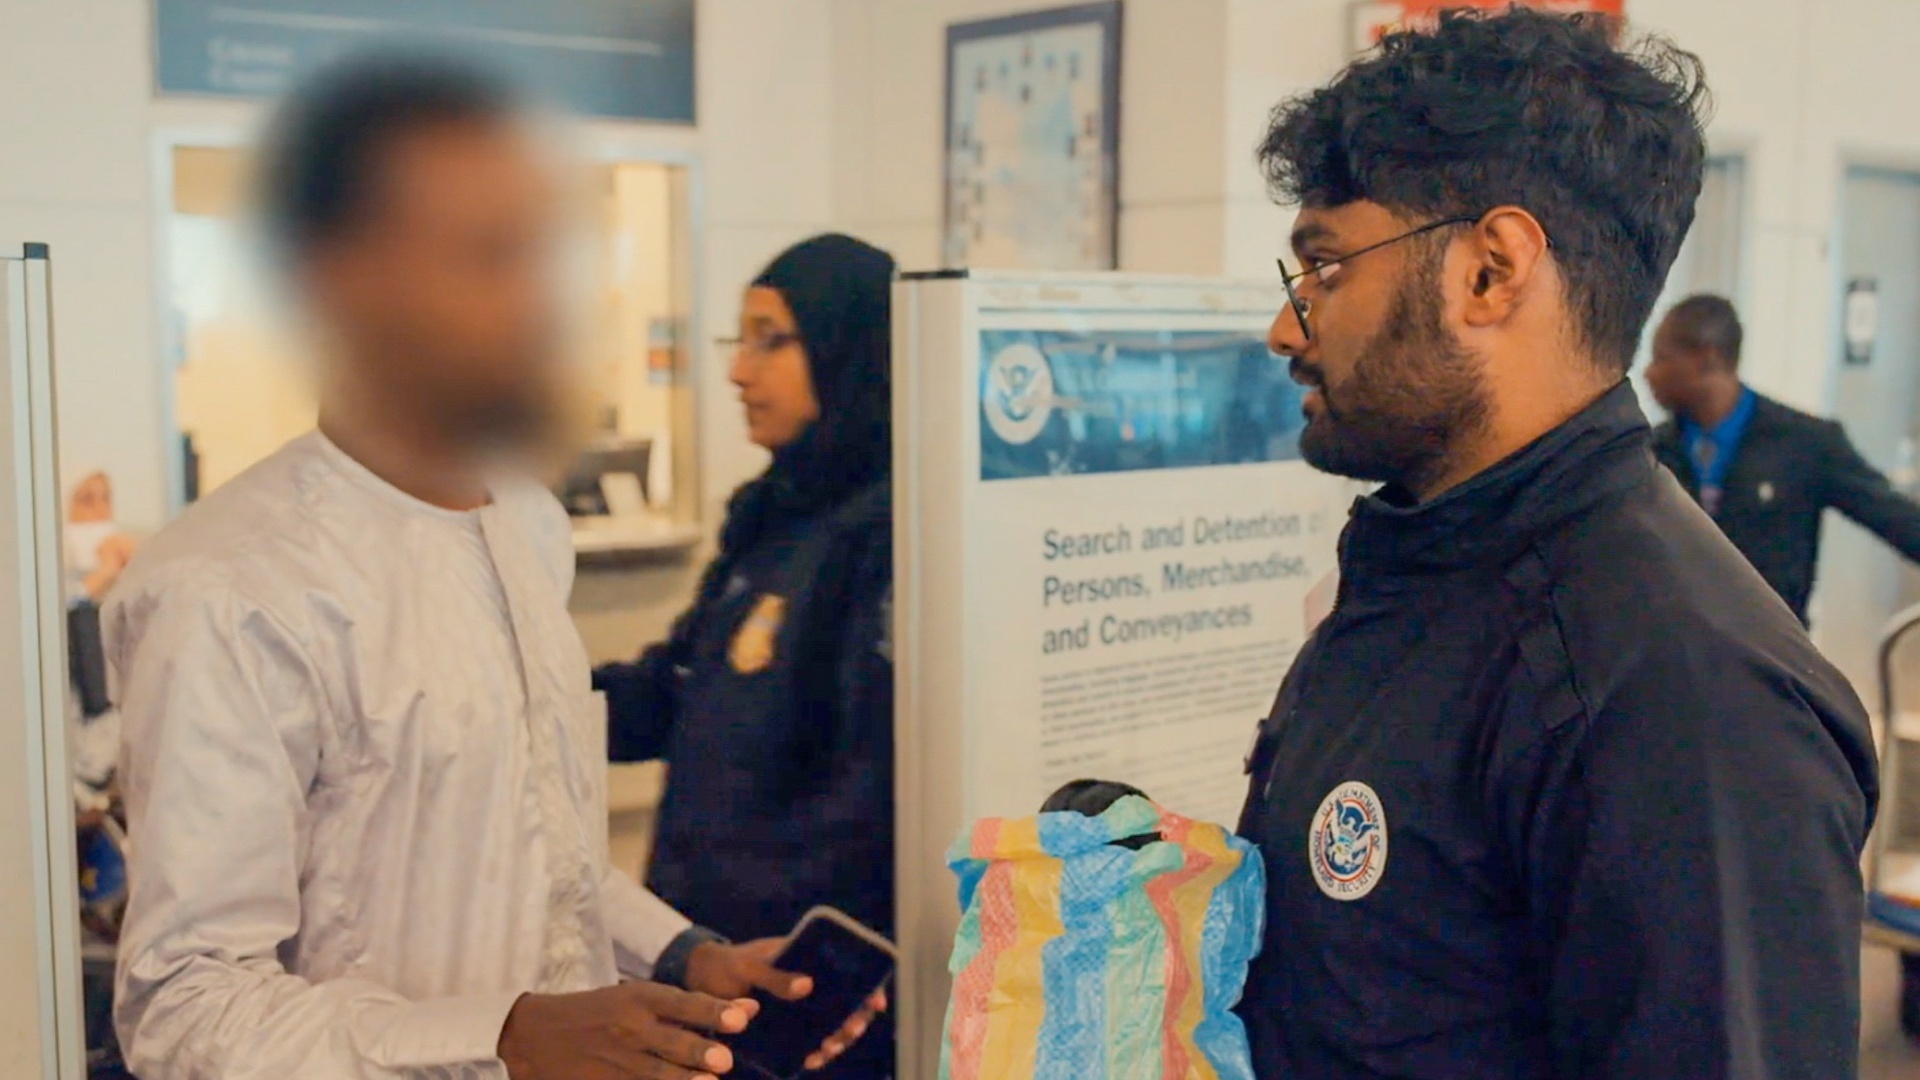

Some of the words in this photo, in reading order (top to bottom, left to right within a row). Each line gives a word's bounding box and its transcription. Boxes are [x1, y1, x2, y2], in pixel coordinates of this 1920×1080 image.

[1043, 523, 1132, 560] Search
[1141, 515, 1184, 550] and
[1193, 512, 1300, 544] Detention
[1043, 574, 1151, 607] Persons,
[1162, 552, 1311, 591] Merchandise,
[1043, 617, 1089, 654] and
[1100, 603, 1252, 645] Conveyances
